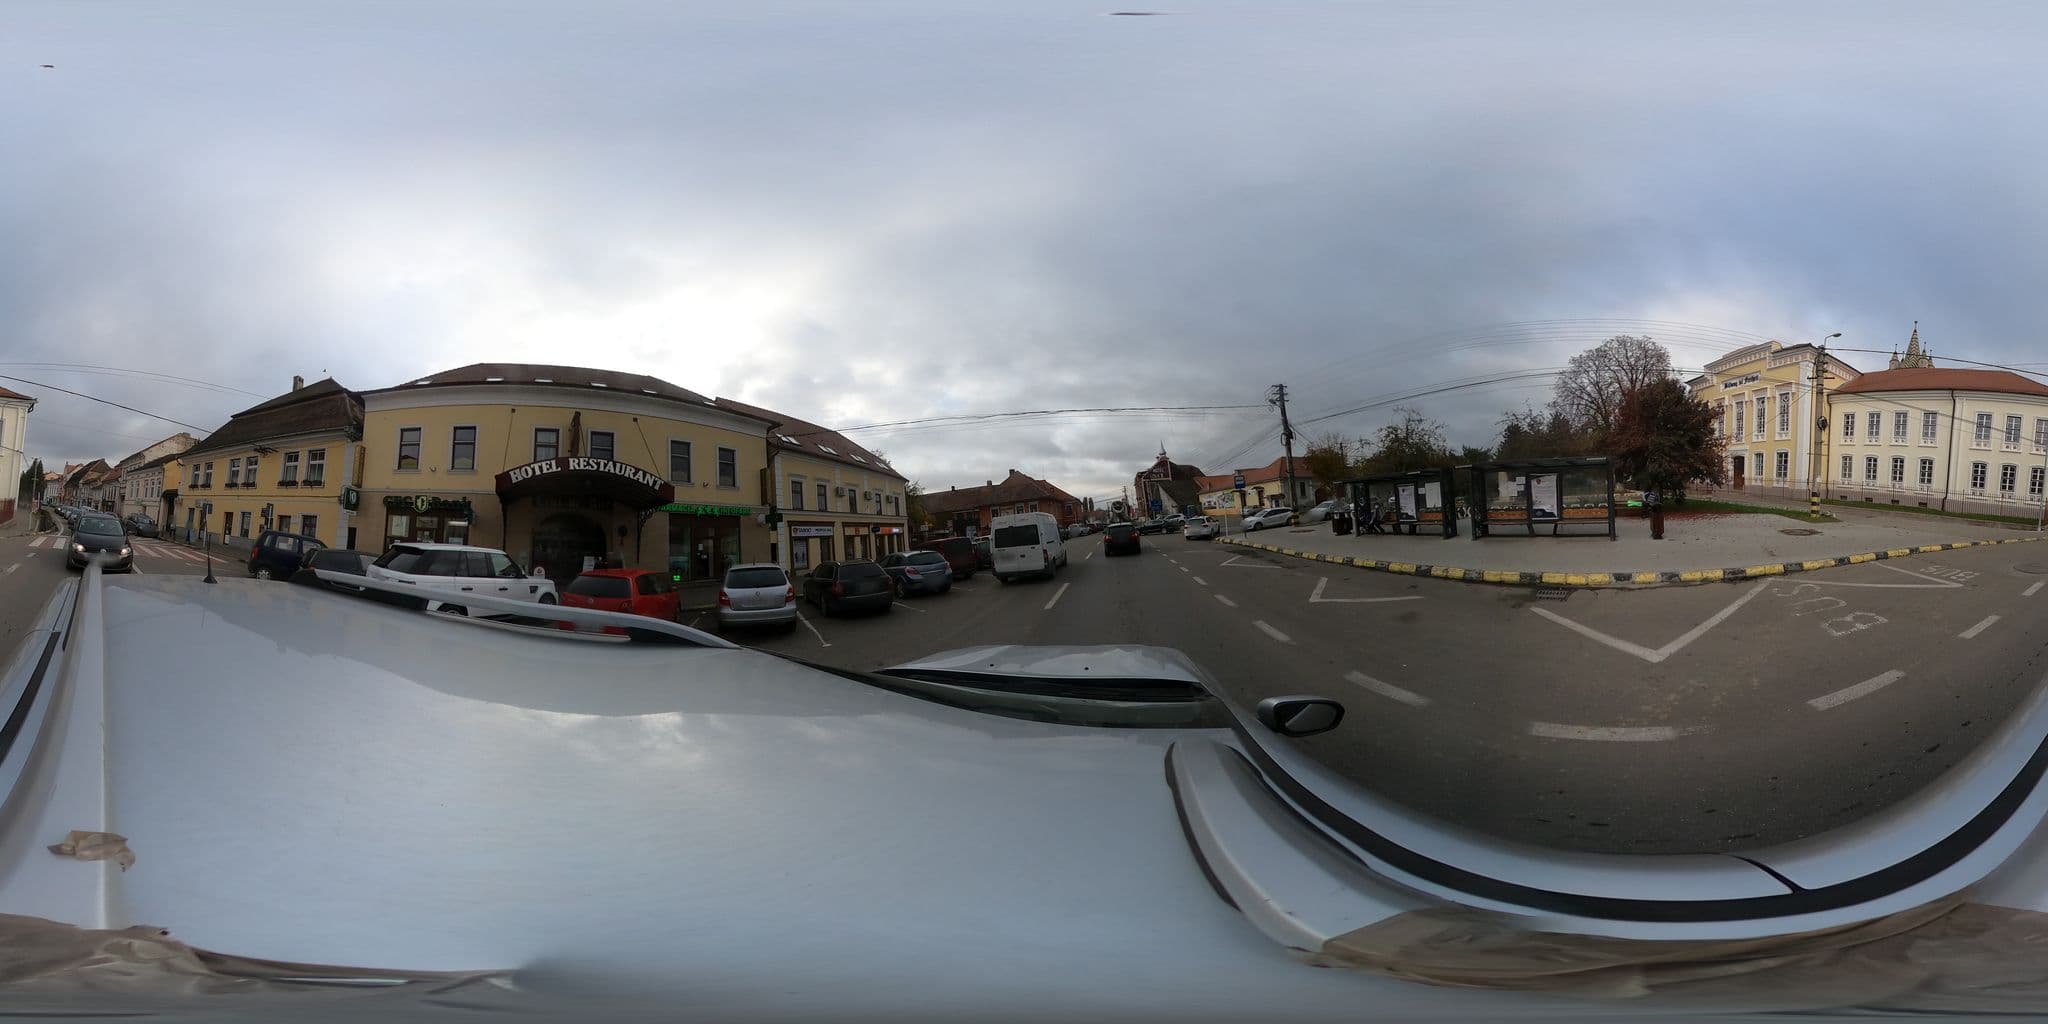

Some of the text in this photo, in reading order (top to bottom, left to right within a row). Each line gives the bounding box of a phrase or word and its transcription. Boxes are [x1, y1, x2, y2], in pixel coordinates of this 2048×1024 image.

[509, 457, 665, 491] HOTEL RESTAURANT
[1773, 583, 1889, 638] BUS
